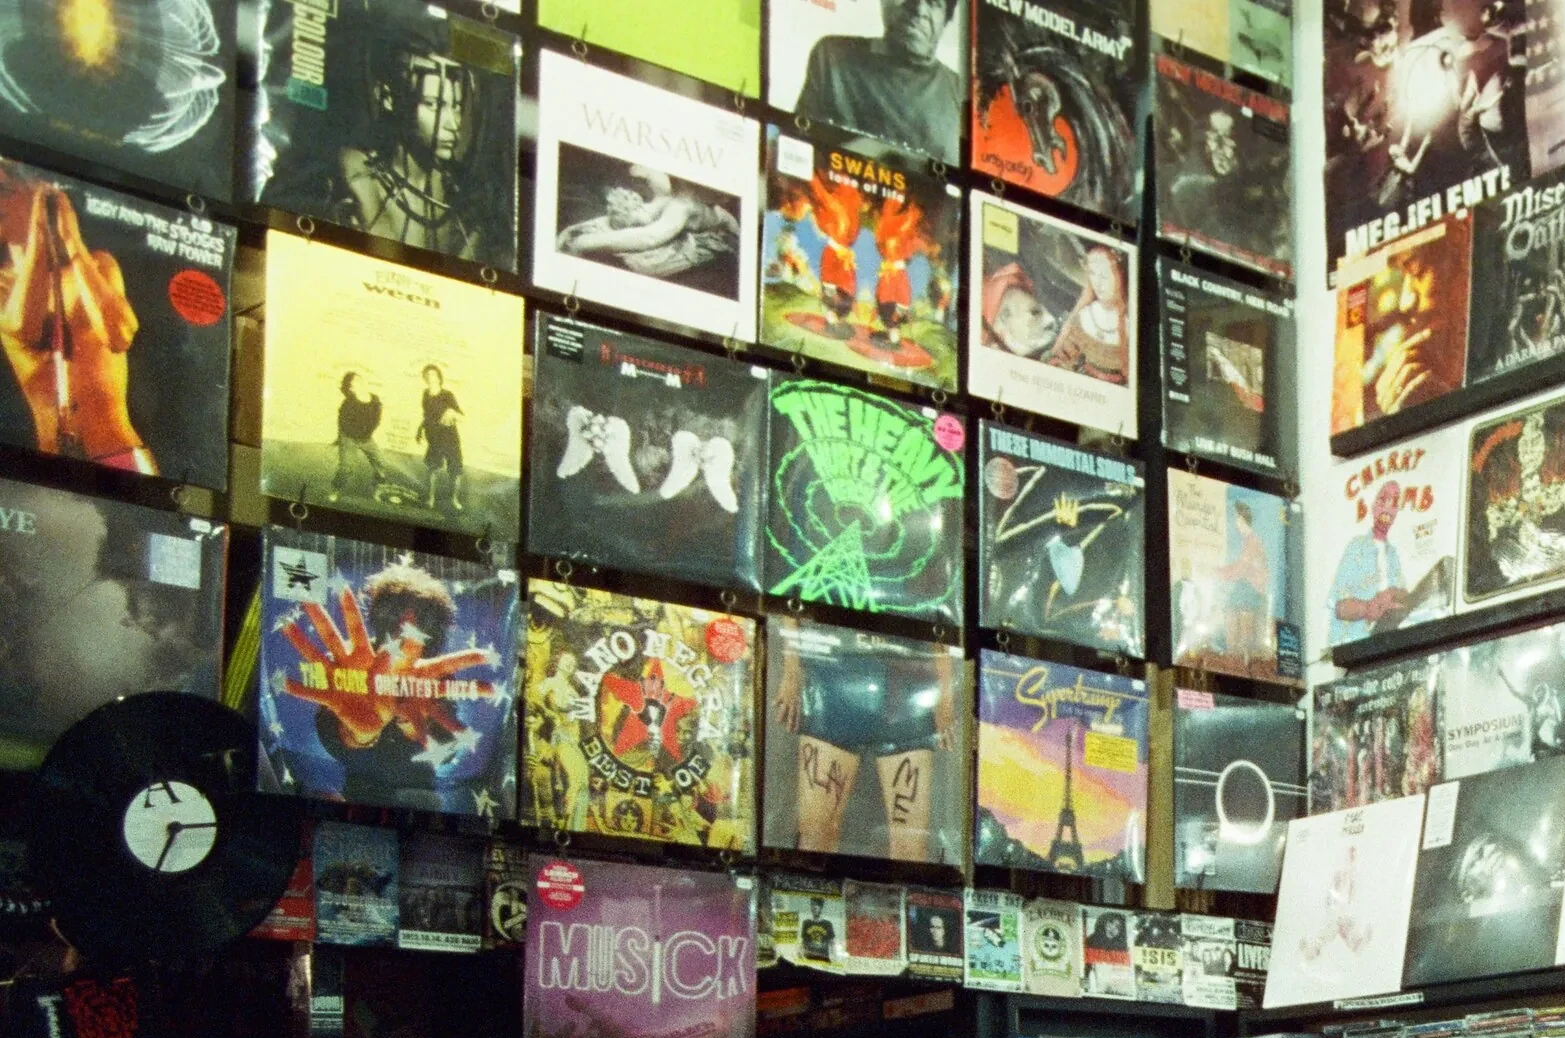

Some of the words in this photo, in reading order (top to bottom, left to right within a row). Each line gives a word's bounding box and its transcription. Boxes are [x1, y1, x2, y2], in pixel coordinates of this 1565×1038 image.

[1024, 5, 1079, 41] MODEL
[1083, 28, 1131, 61] ARMY
[581, 103, 724, 169] WARSAW
[179, 239, 223, 269] POWER
[1171, 269, 1200, 289] BLACK
[363, 281, 440, 309] ween
[1345, 449, 1426, 500] CHERRY
[375, 674, 437, 699] GREATEST
[569, 629, 636, 725] MANO
[643, 629, 729, 742] NEGRA
[1447, 713, 1525, 740] SYMPOSIUM
[579, 738, 652, 797] BEST
[673, 753, 708, 790] OF
